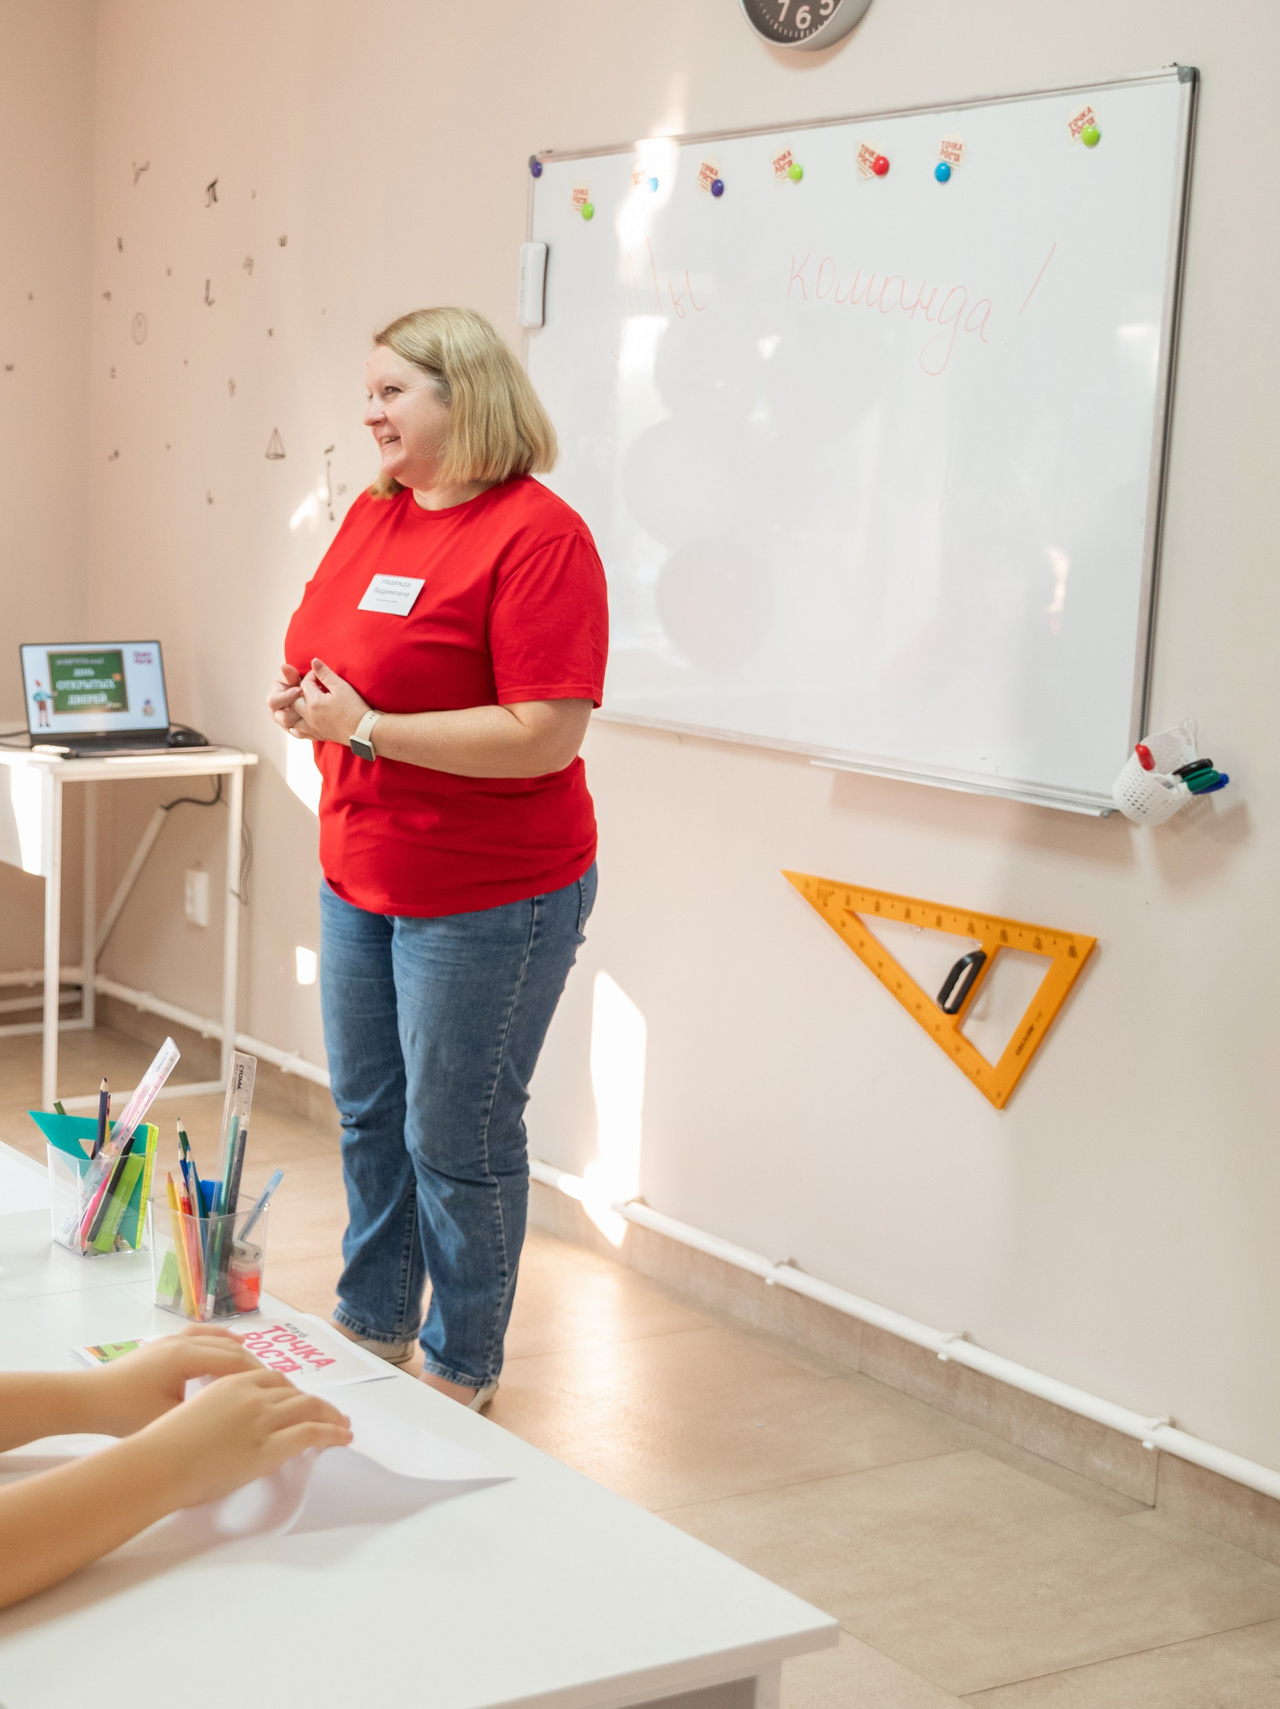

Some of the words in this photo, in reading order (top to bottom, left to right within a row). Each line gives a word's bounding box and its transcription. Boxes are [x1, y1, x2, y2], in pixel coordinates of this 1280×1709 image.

[778, 0, 791, 22] 7
[795, 5, 812, 30] 6
[283, 1322, 310, 1339] клуб
[243, 1331, 303, 1374] РОСТА
[260, 1325, 337, 1369] ТОЧКА
